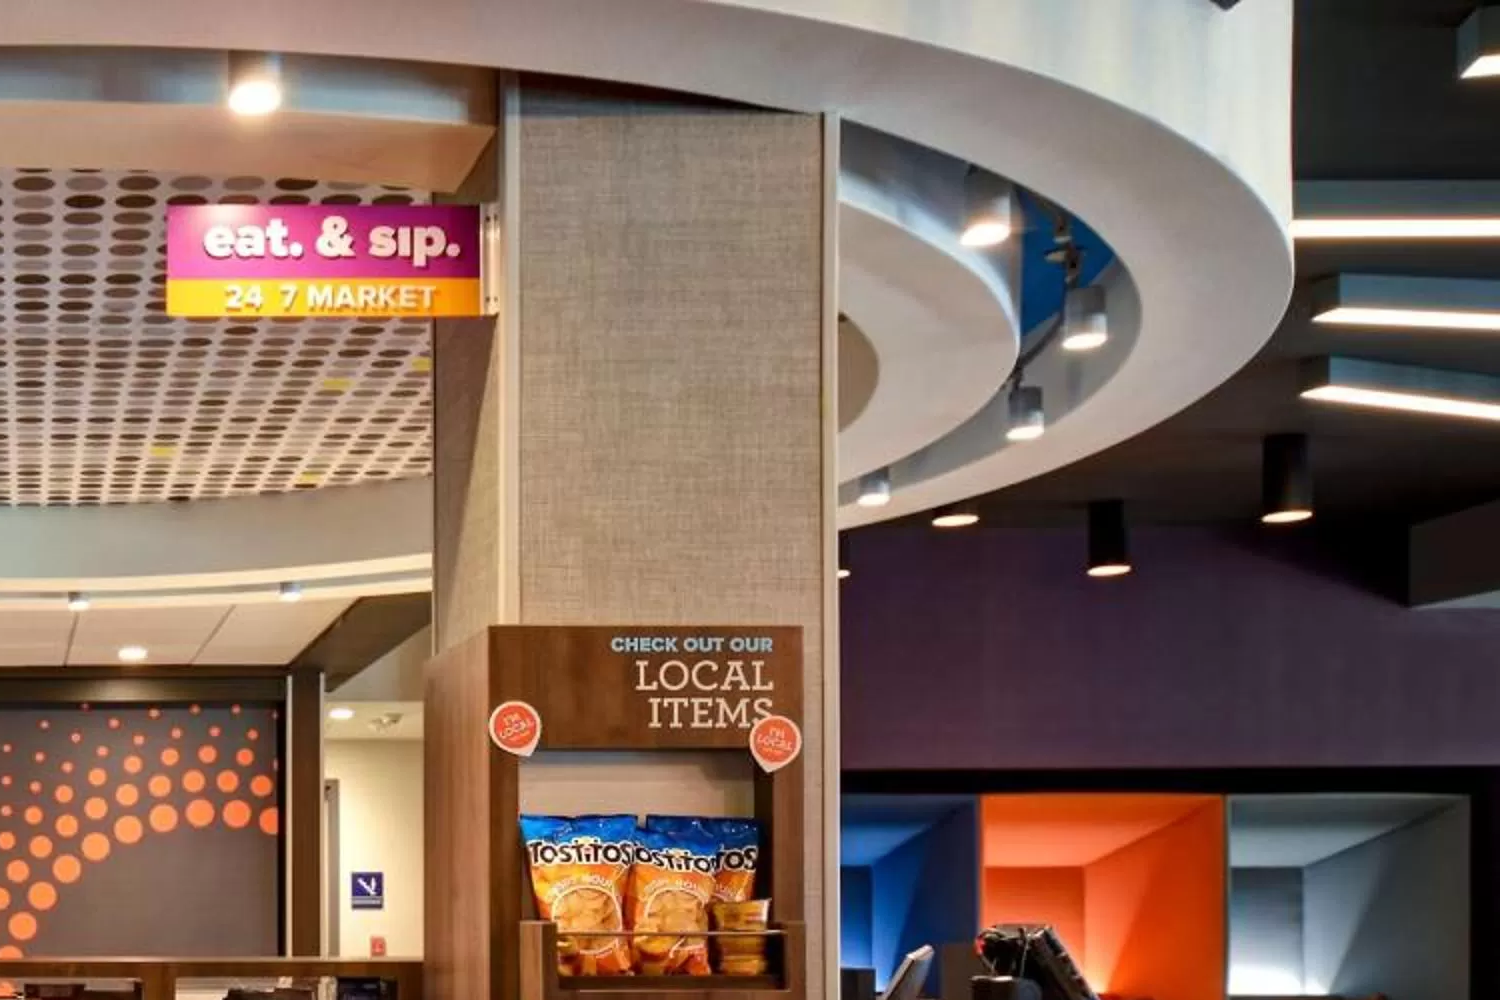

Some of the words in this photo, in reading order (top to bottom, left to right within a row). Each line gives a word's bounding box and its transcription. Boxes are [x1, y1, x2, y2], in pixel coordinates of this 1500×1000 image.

[204, 218, 303, 258] eat.
[316, 216, 355, 257] &
[368, 225, 461, 267] sip.
[308, 284, 437, 309] MARKET
[611, 637, 679, 652] CHECK
[684, 637, 725, 652] OUT
[730, 637, 773, 652] OUR
[635, 660, 774, 691] LOCAL
[648, 698, 774, 728] ITEMS
